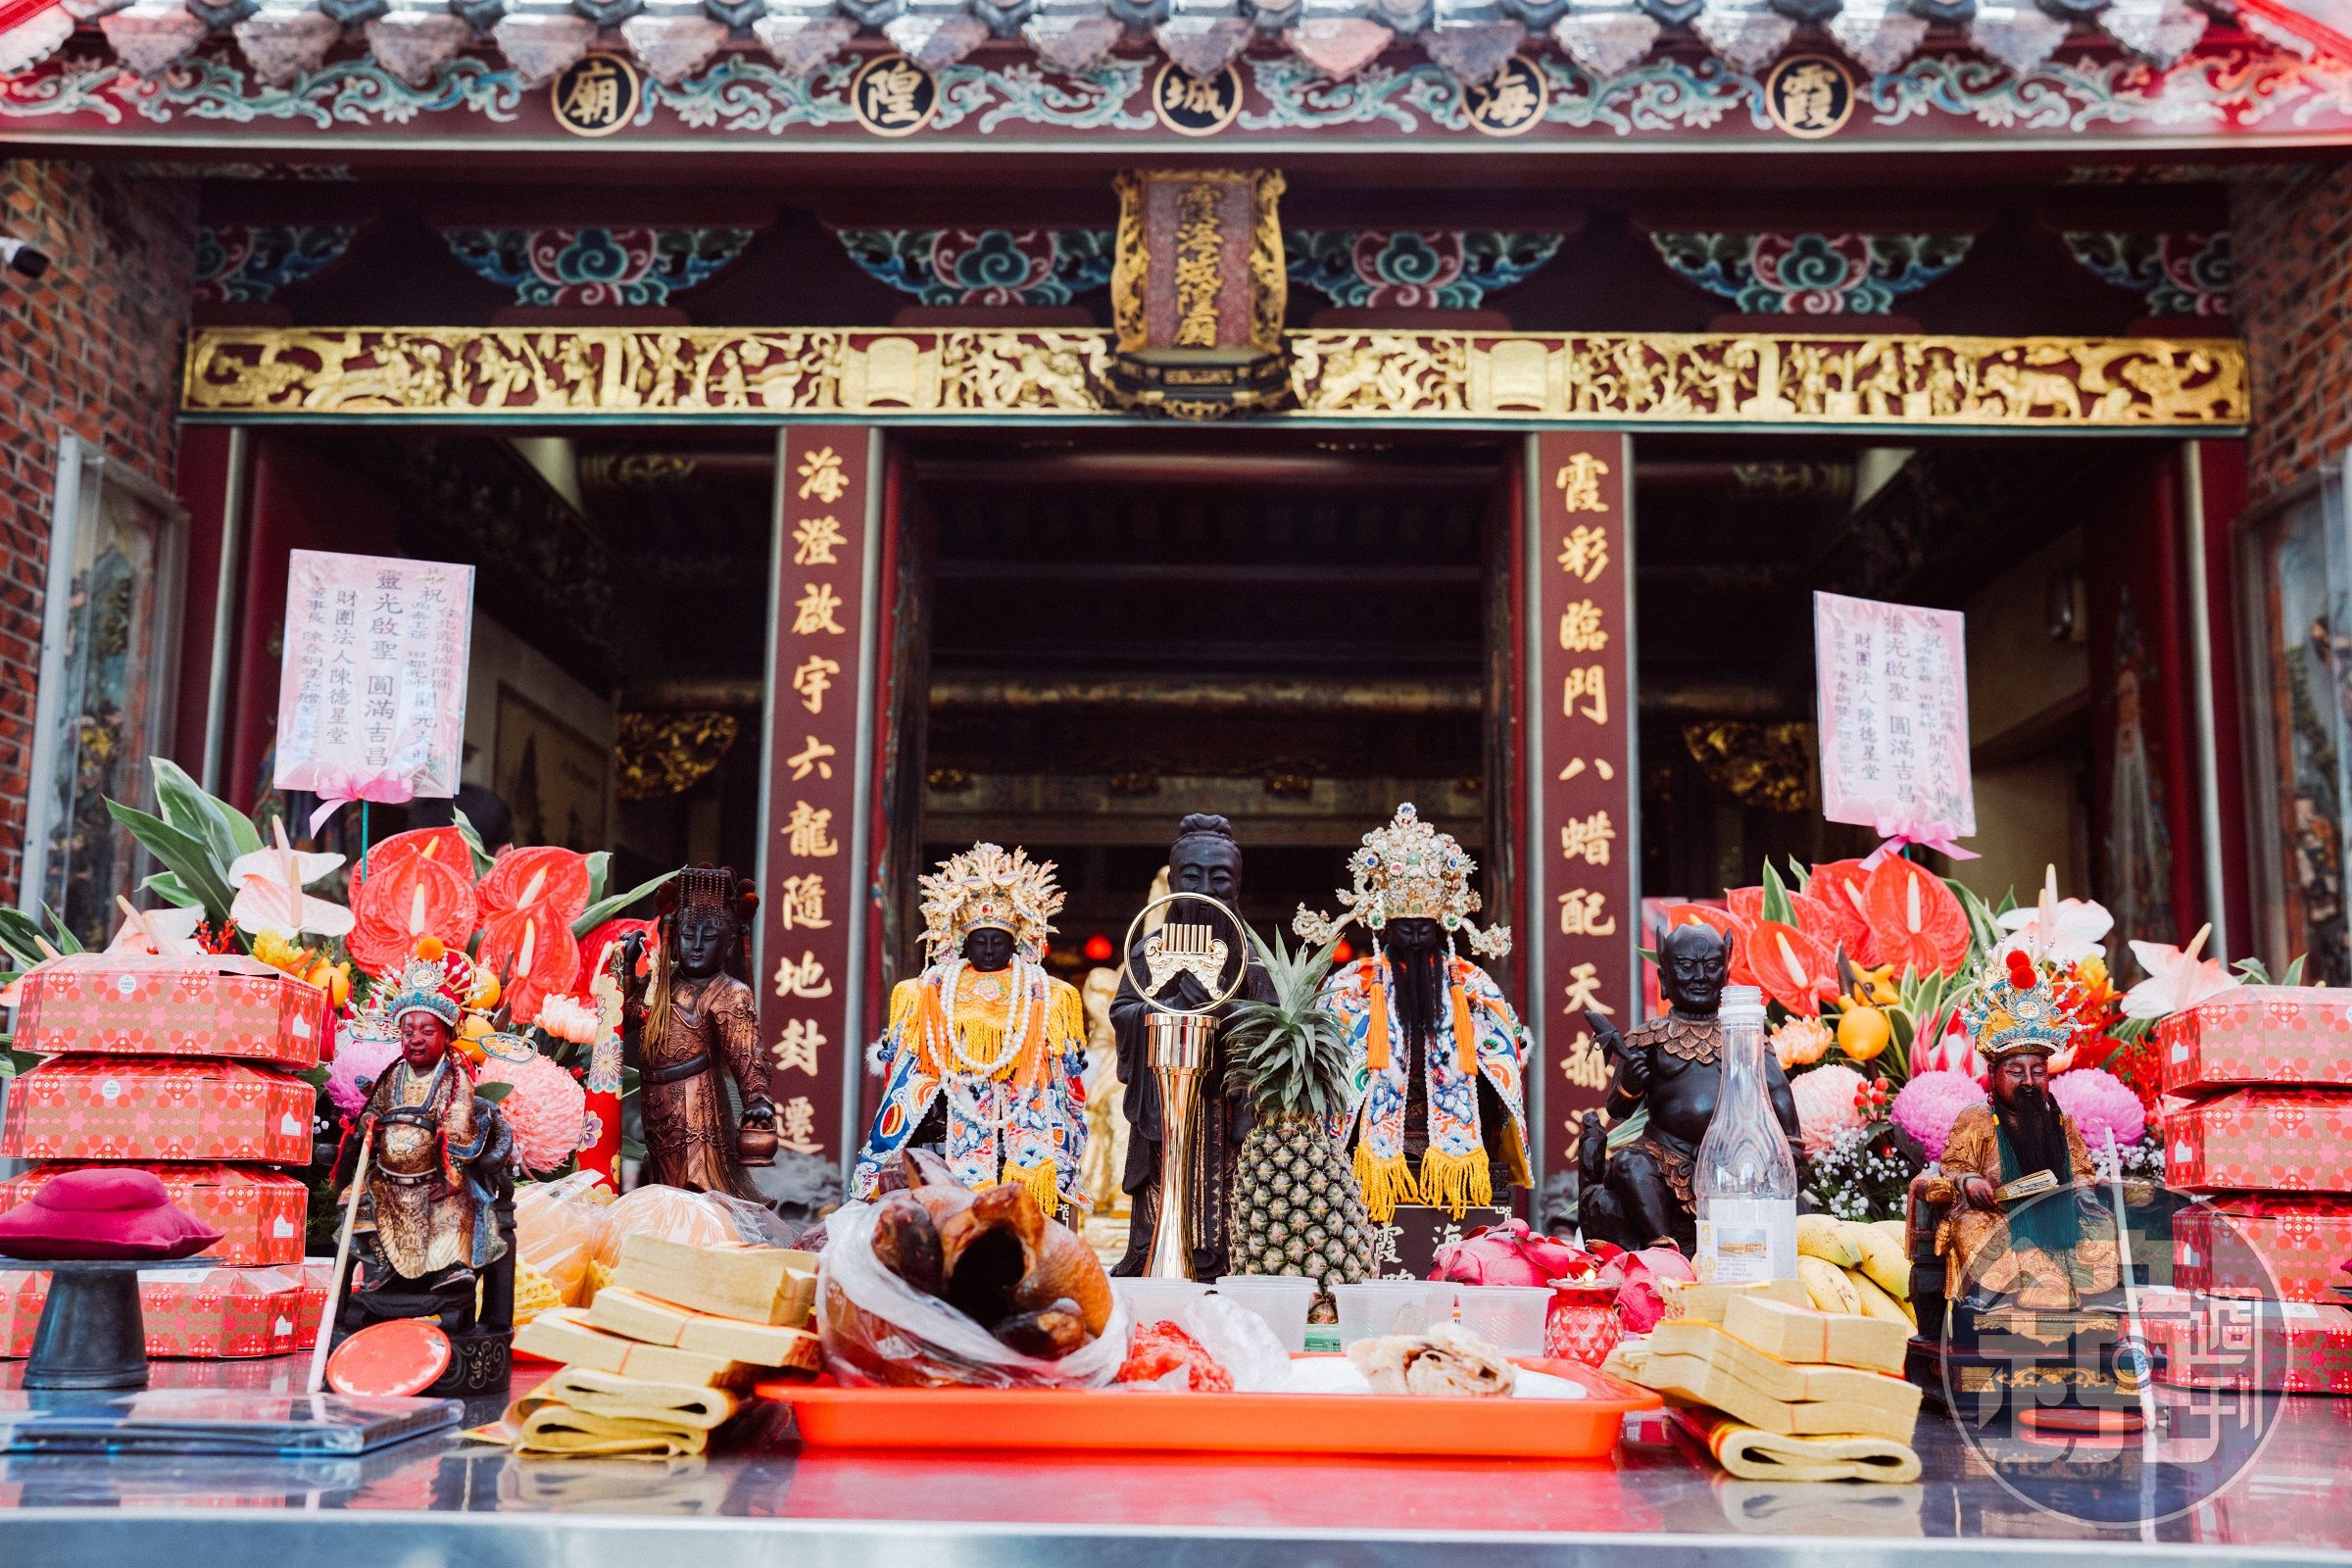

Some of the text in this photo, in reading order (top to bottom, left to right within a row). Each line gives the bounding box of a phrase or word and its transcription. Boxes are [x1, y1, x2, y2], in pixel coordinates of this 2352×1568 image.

[325, 589, 357, 746] 財團法人陳德星堂
[365, 675, 396, 768] 圓滿吉昌
